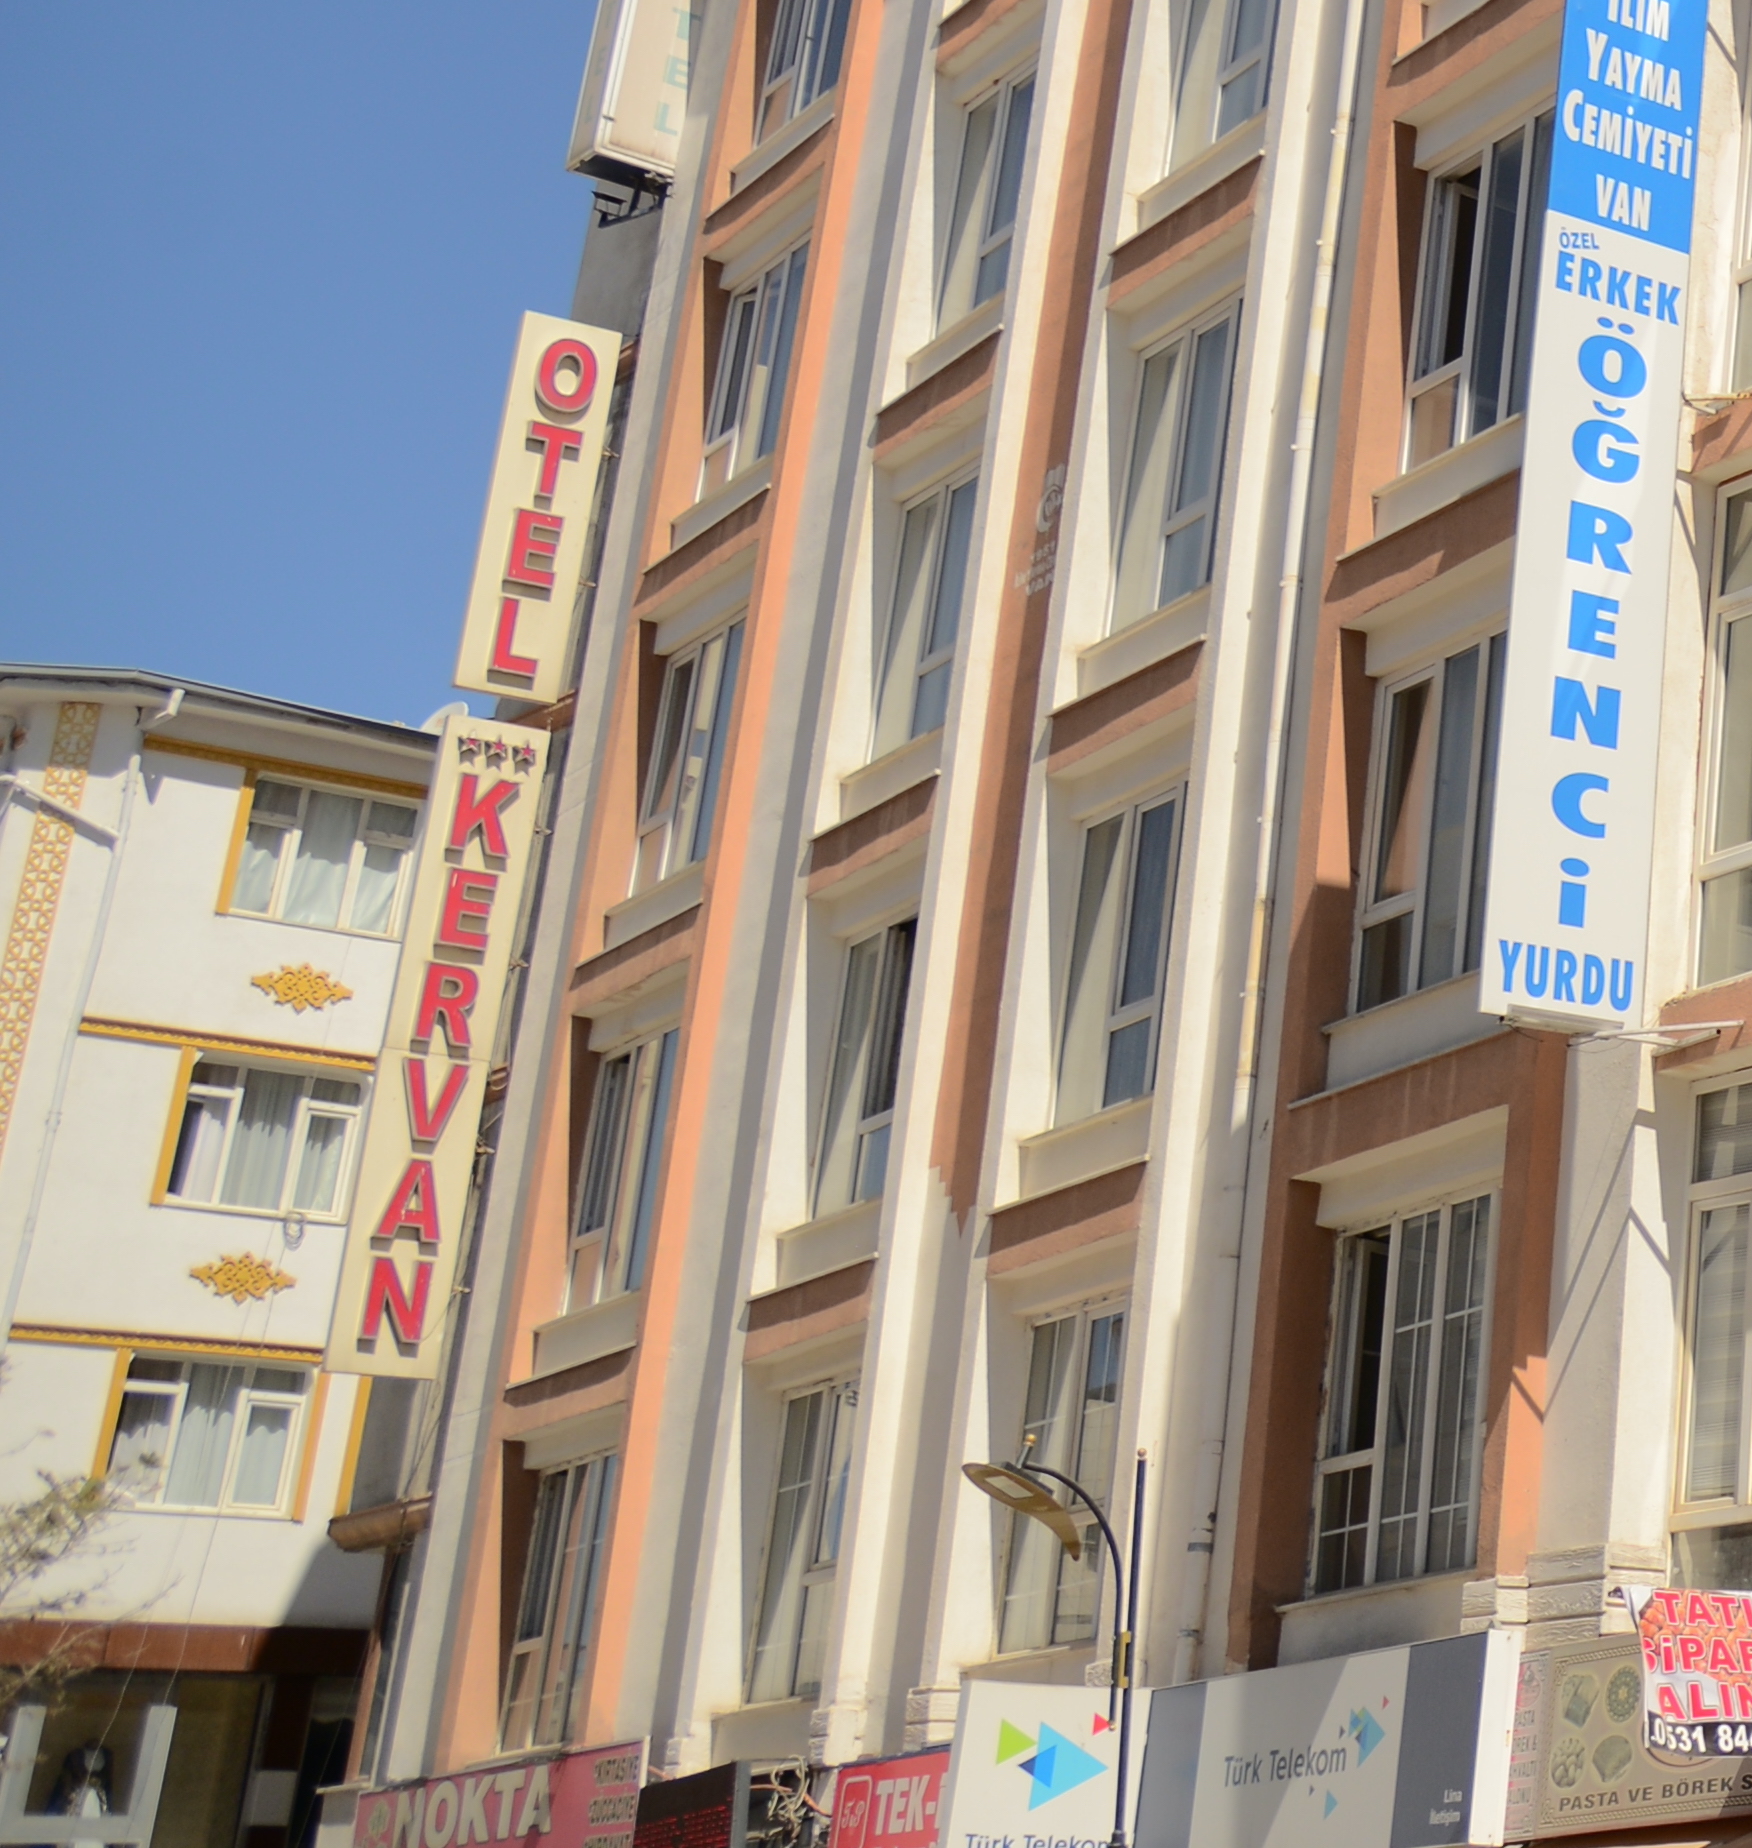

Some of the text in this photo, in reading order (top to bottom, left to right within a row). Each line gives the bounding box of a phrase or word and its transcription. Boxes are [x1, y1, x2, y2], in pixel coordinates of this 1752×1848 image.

[1586, 27, 1682, 111] YAYMA
[1563, 88, 1692, 180] CEMİYETİ
[1559, 226, 1600, 251] ÖZEL
[1596, 174, 1651, 232] VAN
[1555, 250, 1681, 325] ERKEK
[487, 338, 599, 680] OTEL
[1549, 316, 1648, 929] ÖĞRENCİ
[1498, 939, 1634, 1012] YURDU
[362, 770, 518, 1348] KERVAN
[1223, 1746, 1347, 1787] Türk Telekom
[1444, 1789, 1463, 1803] Lina
[1559, 1791, 1619, 1812] PASTA
[1628, 1788, 1652, 1803] VE
[1662, 1778, 1733, 1799] BÖREK
[392, 1764, 552, 1848] NOKTA
[965, 1834, 1015, 1848] Türk
[1429, 1808, 1461, 1826] İletişim
